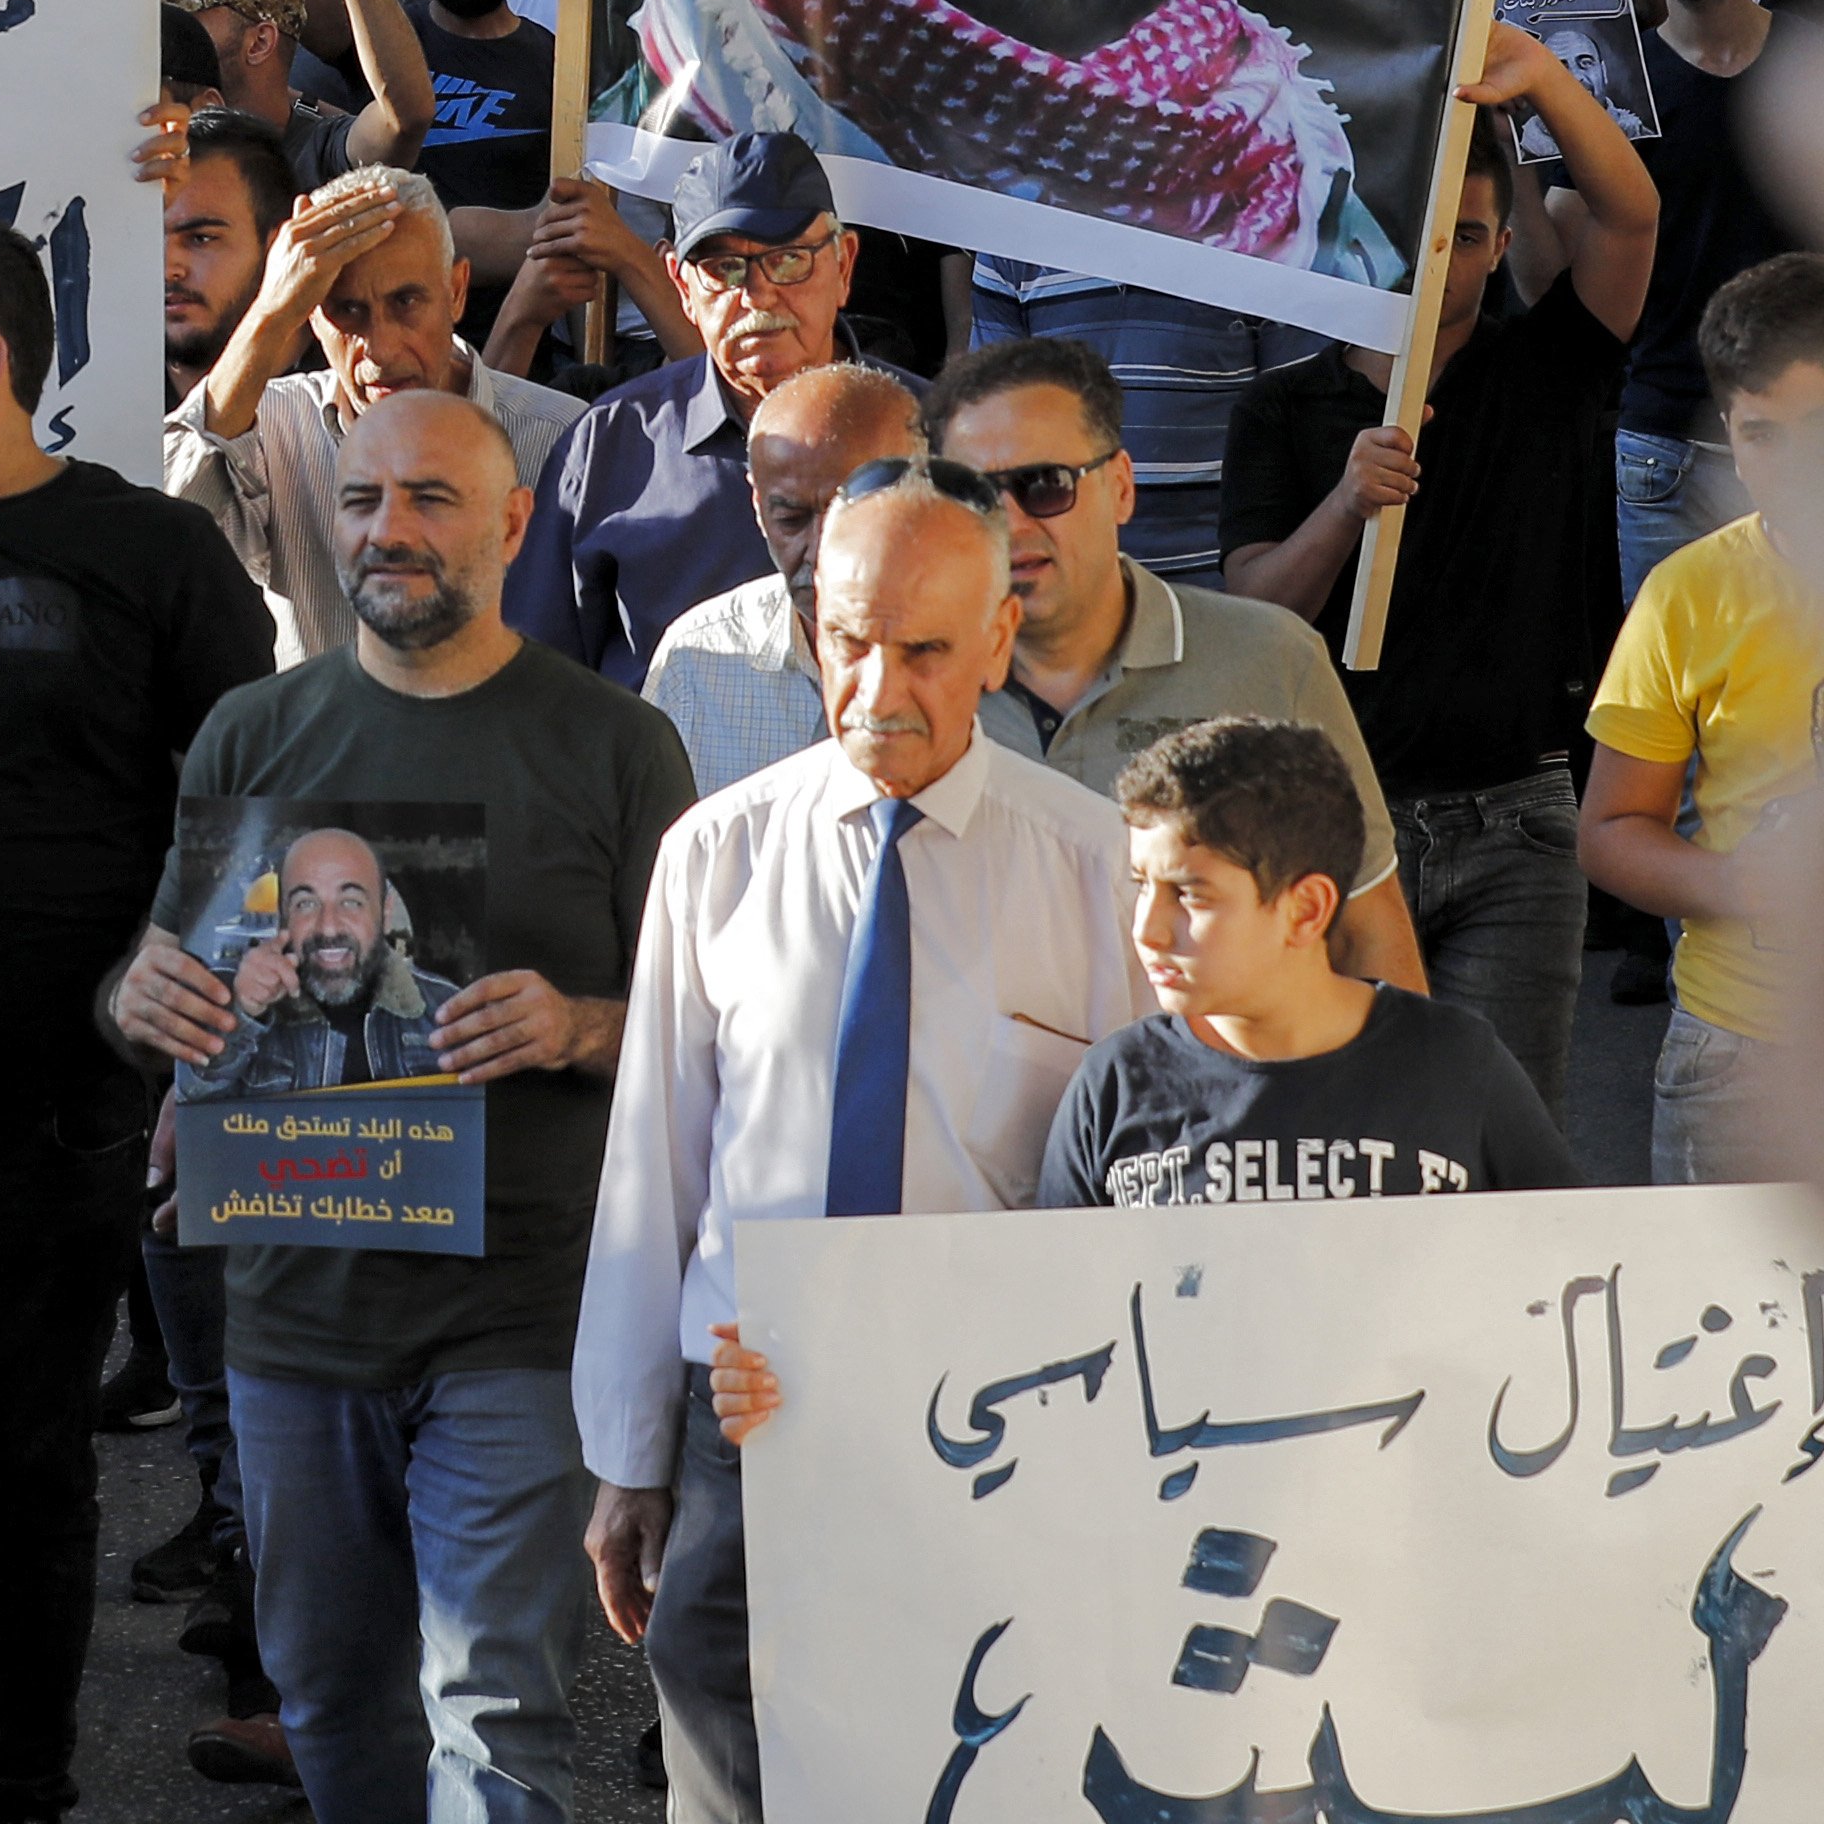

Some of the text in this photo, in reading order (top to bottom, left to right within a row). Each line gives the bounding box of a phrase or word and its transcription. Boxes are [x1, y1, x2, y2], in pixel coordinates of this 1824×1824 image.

[222, 1112, 455, 1144] هذه البلد تستحق منك
[258, 1146, 402, 1191] أن تضحي
[1205, 1137, 1395, 1203] SELECT
[210, 1189, 455, 1226] صعد خطابك تخافش
[926, 1281, 1425, 1502] سياسي
